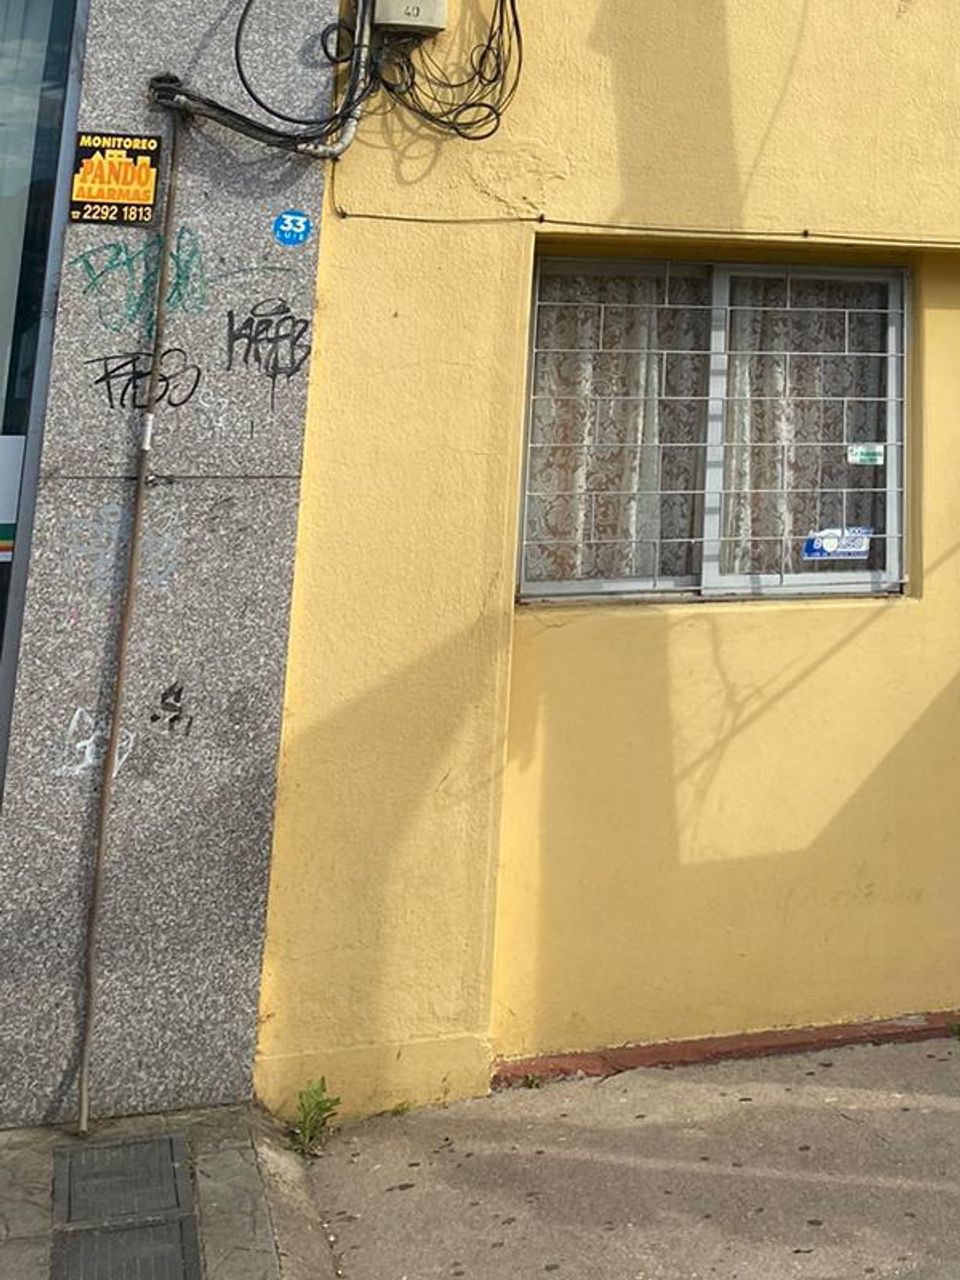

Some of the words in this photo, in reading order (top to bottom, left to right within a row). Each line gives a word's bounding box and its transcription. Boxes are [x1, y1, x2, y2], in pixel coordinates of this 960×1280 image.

[79, 135, 158, 151] MONITOREO
[80, 160, 150, 187] PANDO
[75, 185, 151, 202] ALARMAS
[83, 204, 118, 220] 2292
[122, 206, 152, 221] 1813
[280, 214, 307, 232] 33
